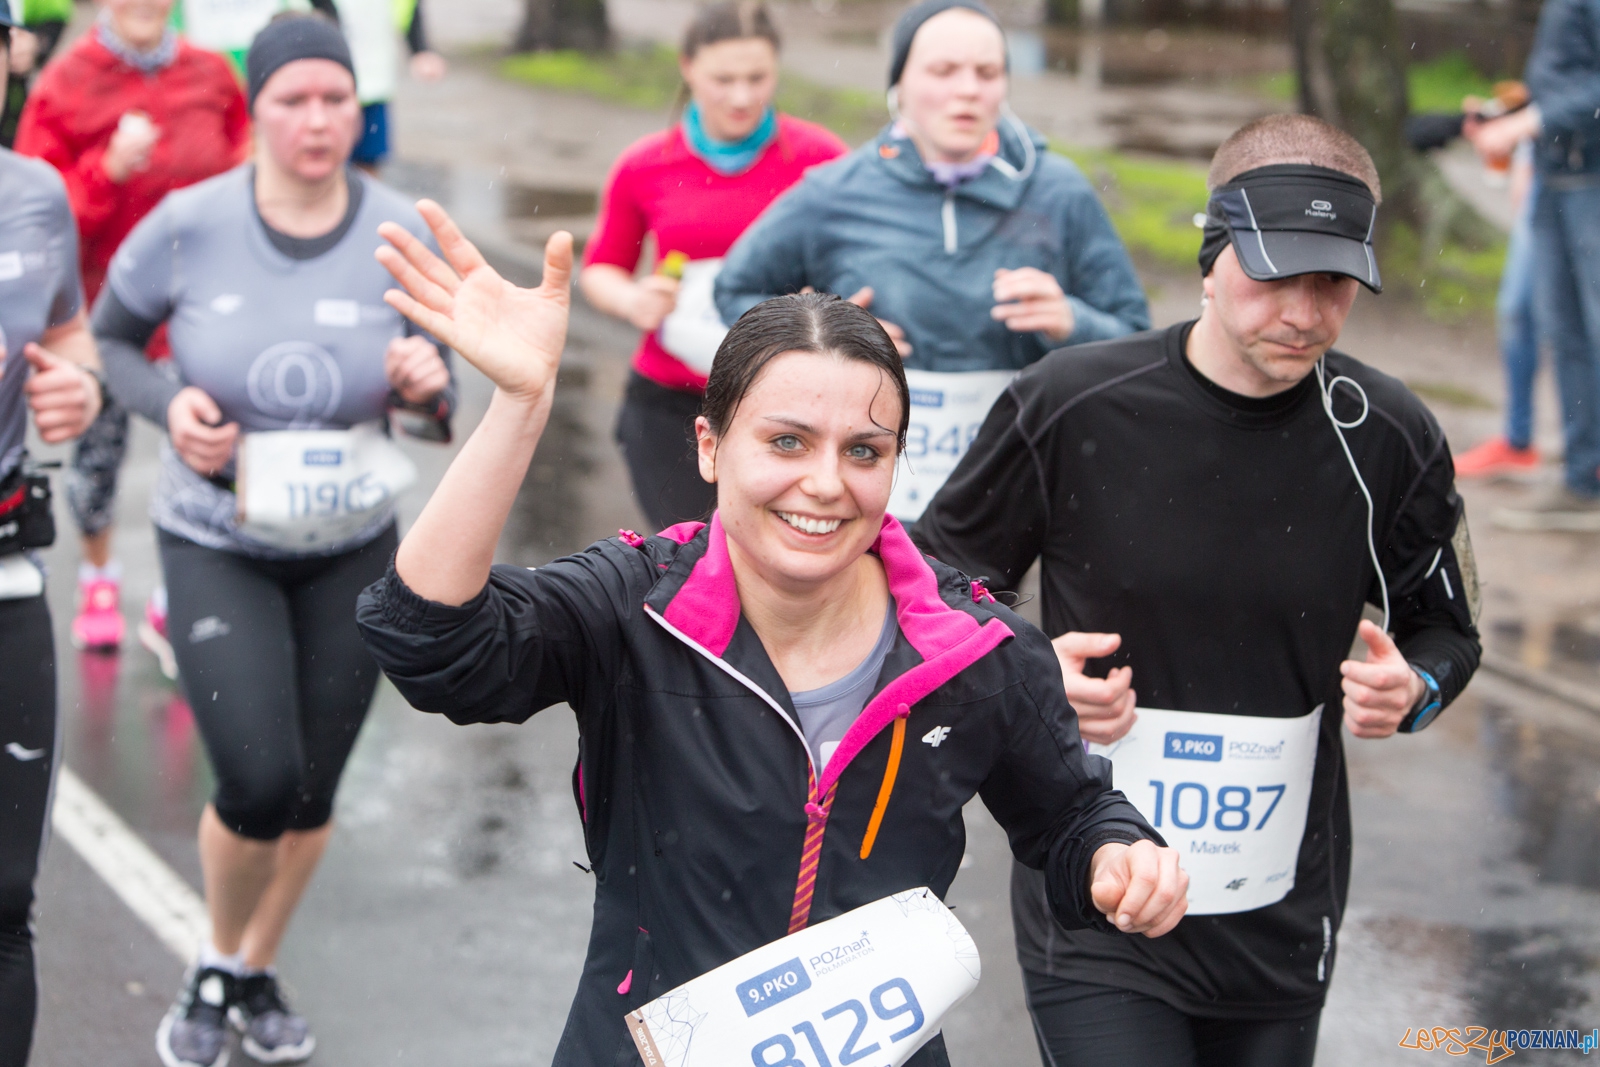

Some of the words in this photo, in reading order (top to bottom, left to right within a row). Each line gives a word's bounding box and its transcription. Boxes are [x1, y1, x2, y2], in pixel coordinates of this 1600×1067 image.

[1305, 208, 1337, 220] Kalenji
[921, 725, 952, 748] 4F
[1171, 738, 1216, 756] 9.PKO
[1149, 780, 1286, 831] 1087
[1189, 840, 1242, 855] Marek
[747, 970, 799, 1004] 9.PKO
[750, 976, 925, 1067] 8129
